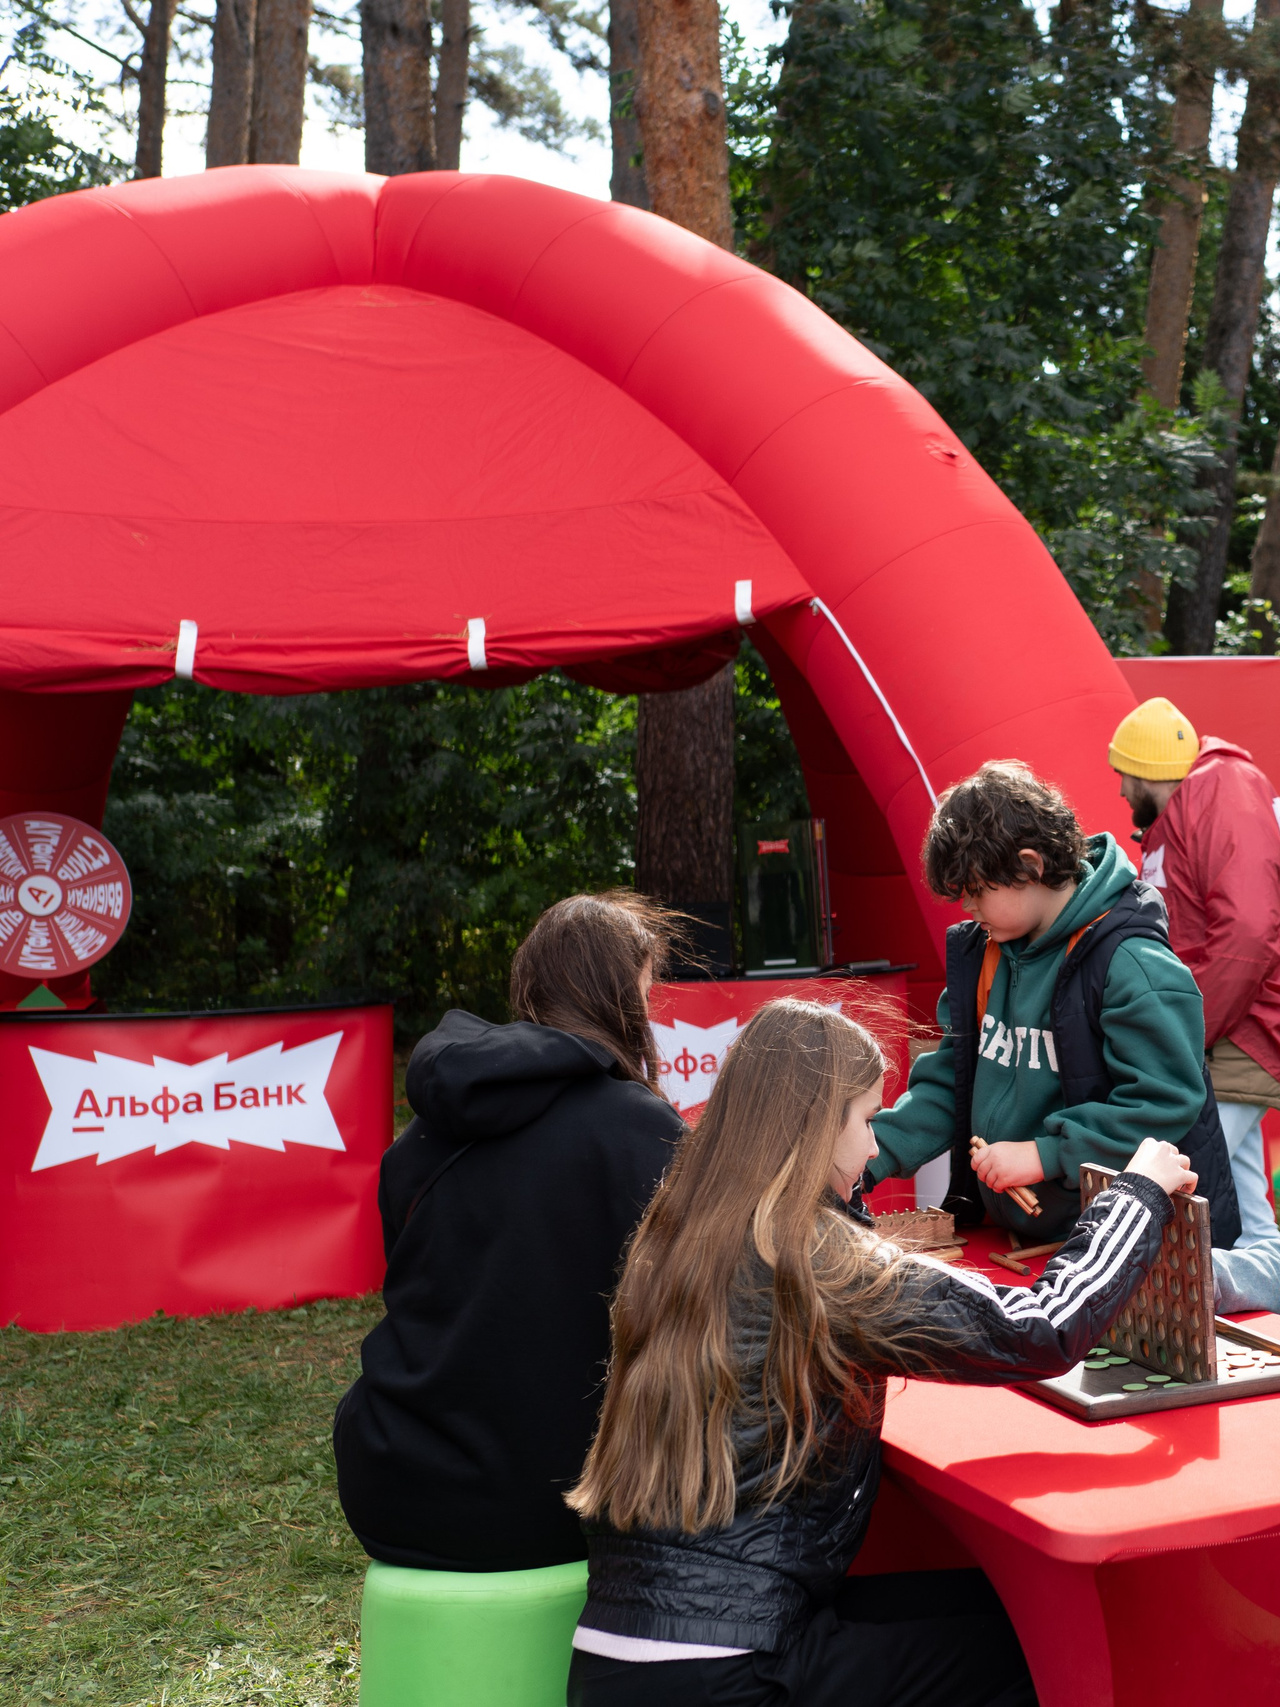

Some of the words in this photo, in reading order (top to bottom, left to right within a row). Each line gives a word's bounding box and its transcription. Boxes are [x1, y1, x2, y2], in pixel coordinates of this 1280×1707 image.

[24, 820, 63, 872] АУТФИТ
[57, 836, 110, 881] СТИЛЬ
[67, 881, 123, 919] ВЫБИРАЙ
[18, 919, 57, 970] АУТФИТ
[54, 910, 107, 961] СПОРТКИТ
[656, 1046, 718, 1083] ьфа
[73, 1086, 203, 1125] Альфа
[214, 1081, 307, 1112] Банк
